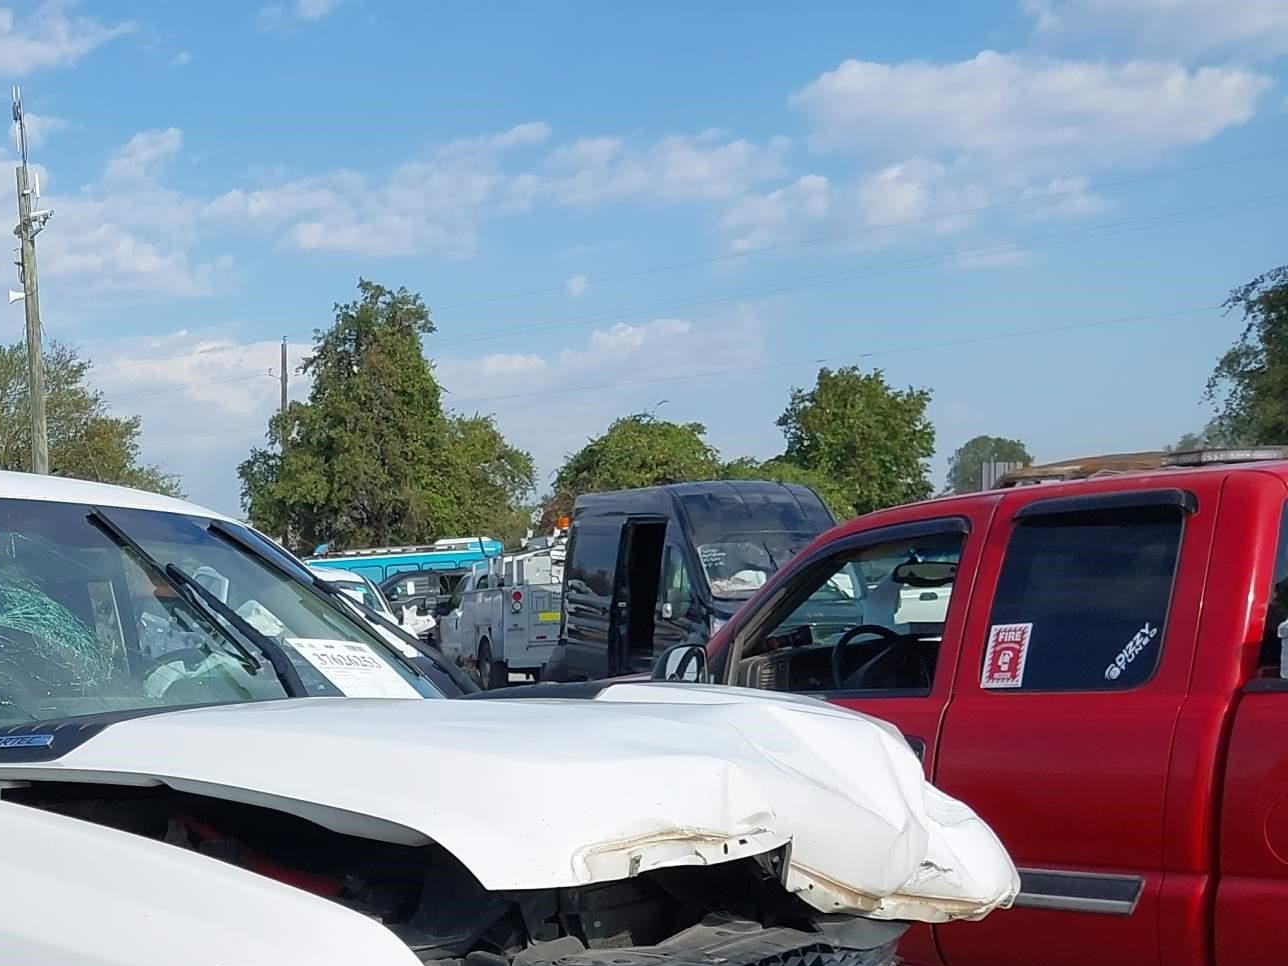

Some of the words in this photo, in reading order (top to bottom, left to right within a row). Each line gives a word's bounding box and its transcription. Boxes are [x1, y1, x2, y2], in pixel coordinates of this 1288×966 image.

[998, 631, 1022, 642] FIRE
[1115, 621, 1149, 667] DIZZY
[312, 652, 382, 669] 37626253
